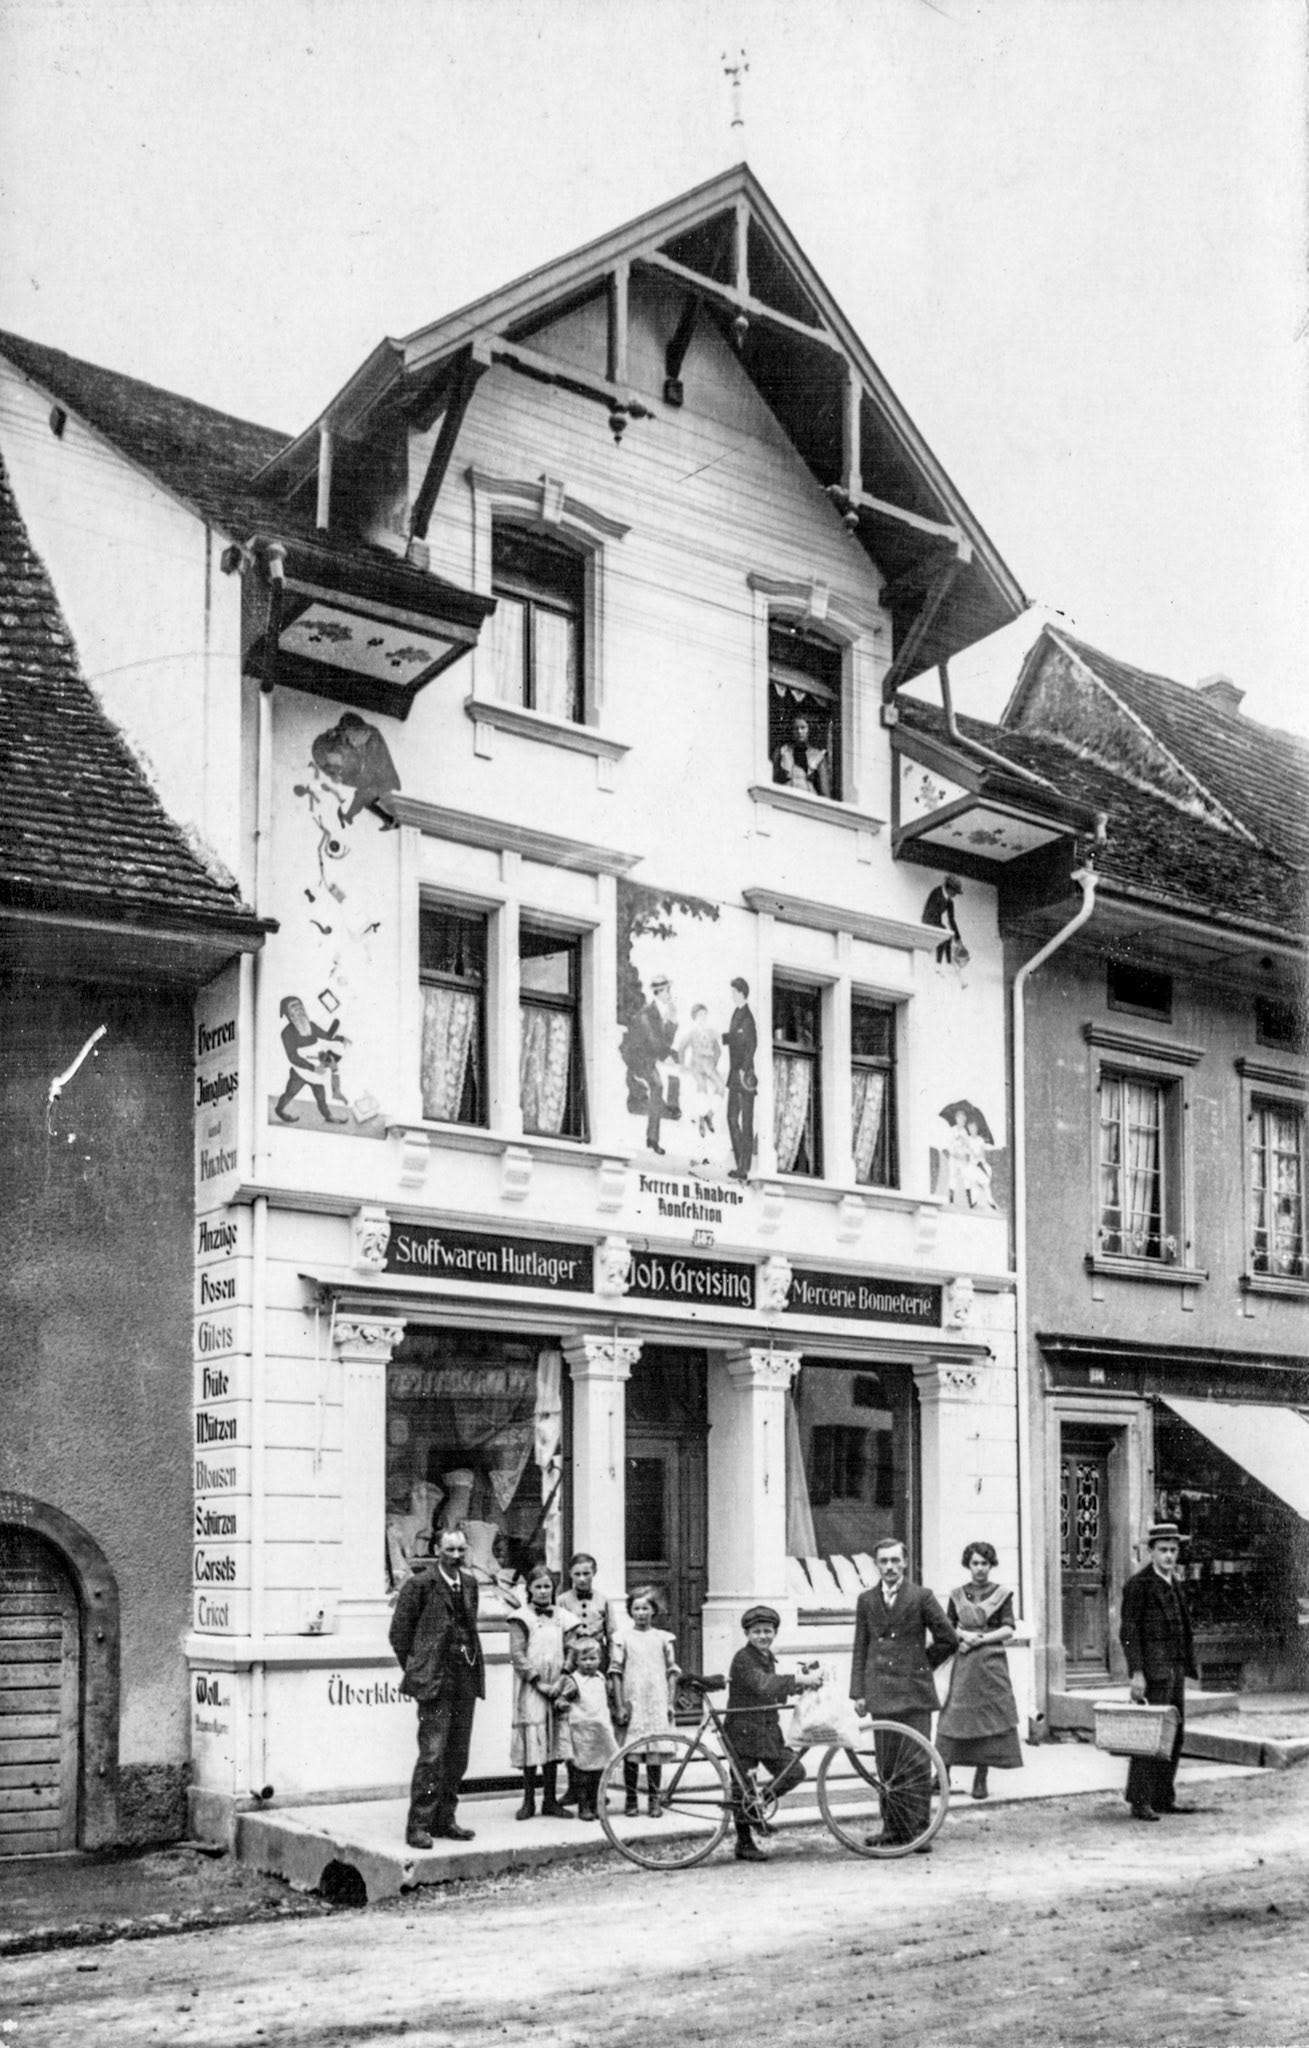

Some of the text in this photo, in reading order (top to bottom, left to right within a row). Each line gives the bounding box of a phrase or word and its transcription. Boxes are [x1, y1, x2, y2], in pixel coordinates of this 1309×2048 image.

[638, 1174, 679, 1197] Herren
[657, 1197, 723, 1224] Konfektion
[197, 1220, 238, 1256] Anzüge
[394, 1234, 578, 1285] Stoffwaren Hutlager
[201, 1272, 236, 1306] Hosen
[629, 1256, 752, 1307] Joh. Greising
[791, 1278, 933, 1317] Mercerie Bonneterie
[198, 1321, 234, 1353] Gilets
[202, 1367, 230, 1400] Hüte
[195, 1412, 238, 1445] Mützen
[195, 1460, 237, 1491] Blousen
[195, 1505, 237, 1537] Schürzen
[194, 1550, 237, 1582] Corsets
